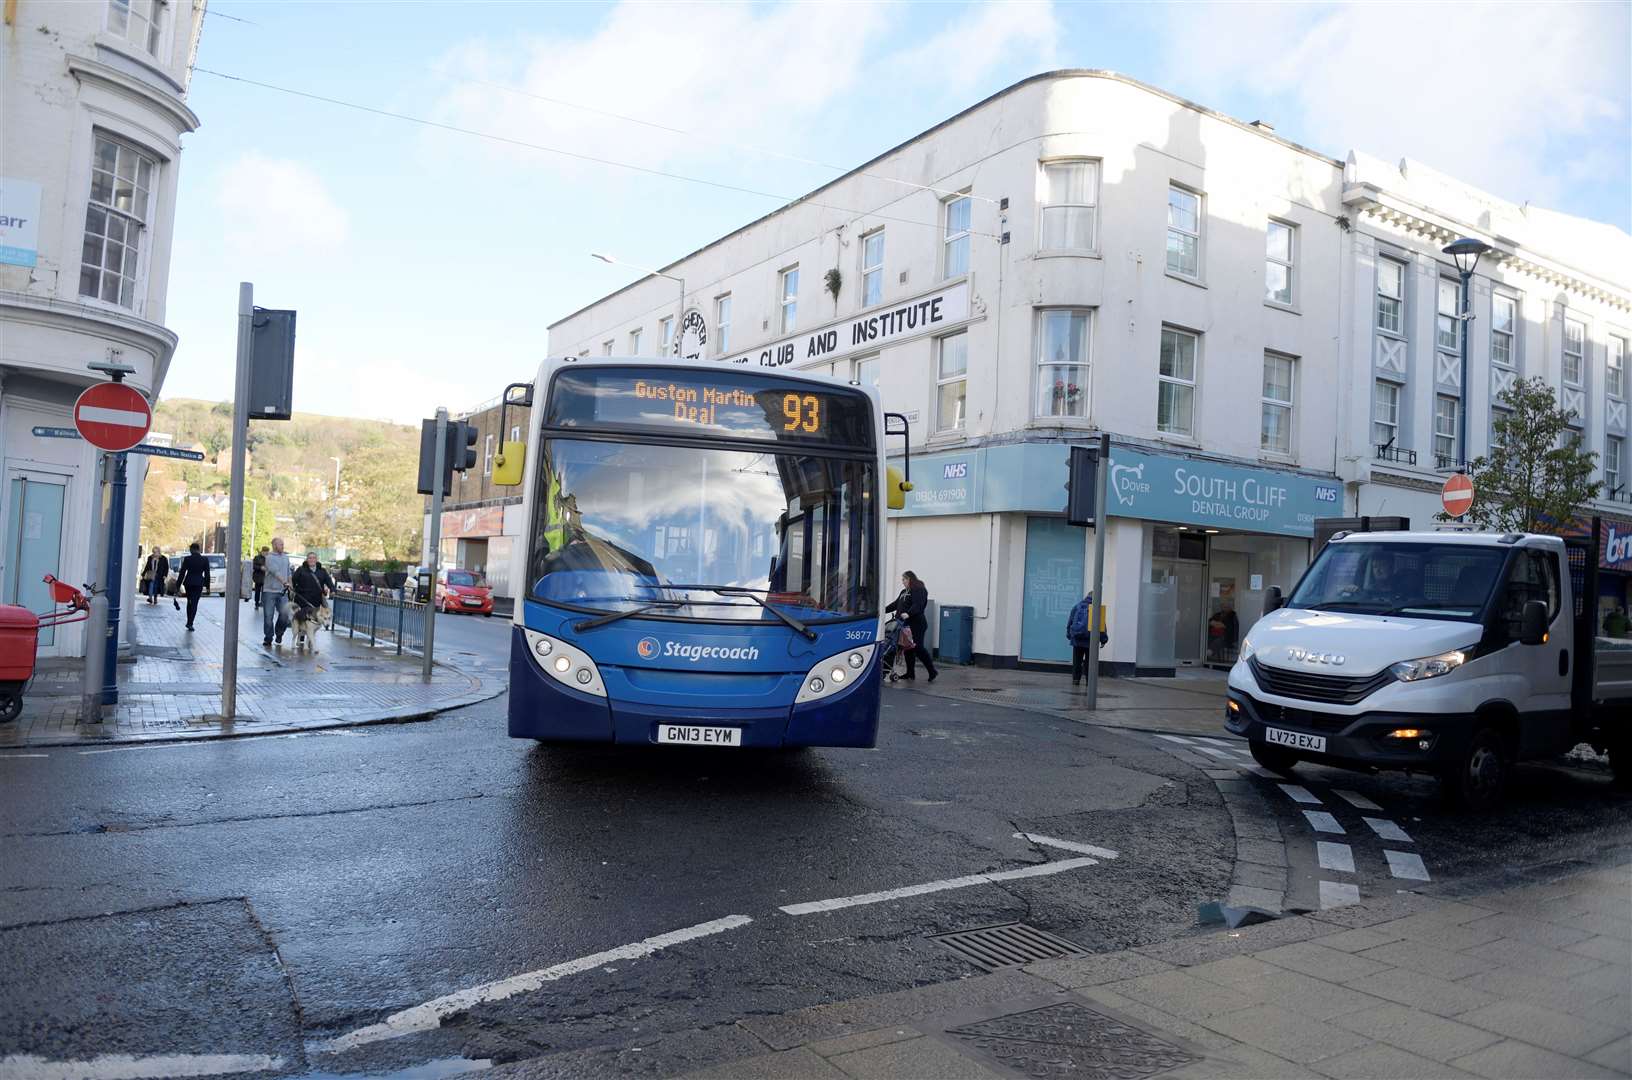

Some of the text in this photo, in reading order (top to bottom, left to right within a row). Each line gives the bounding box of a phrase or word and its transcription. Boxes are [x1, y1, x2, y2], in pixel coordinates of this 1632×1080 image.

[760, 297, 943, 367] CLUB AND INSTITUTE
[634, 381, 755, 408] Guston Martin
[674, 402, 716, 425] Deal
[783, 394, 819, 433] 93
[944, 463, 967, 478] NHS
[1121, 477, 1150, 494] DOVER
[1174, 468, 1287, 508] SOUTH CLIFF
[1315, 487, 1337, 501] NHS
[1192, 500, 1270, 521] DENTAL GROUP
[845, 630, 872, 640] 36877
[664, 641, 759, 662] Stagecoach
[1287, 649, 1346, 666] IVECO
[667, 726, 732, 743] GN13 EYM
[1269, 729, 1321, 750] LV73 EXJ
